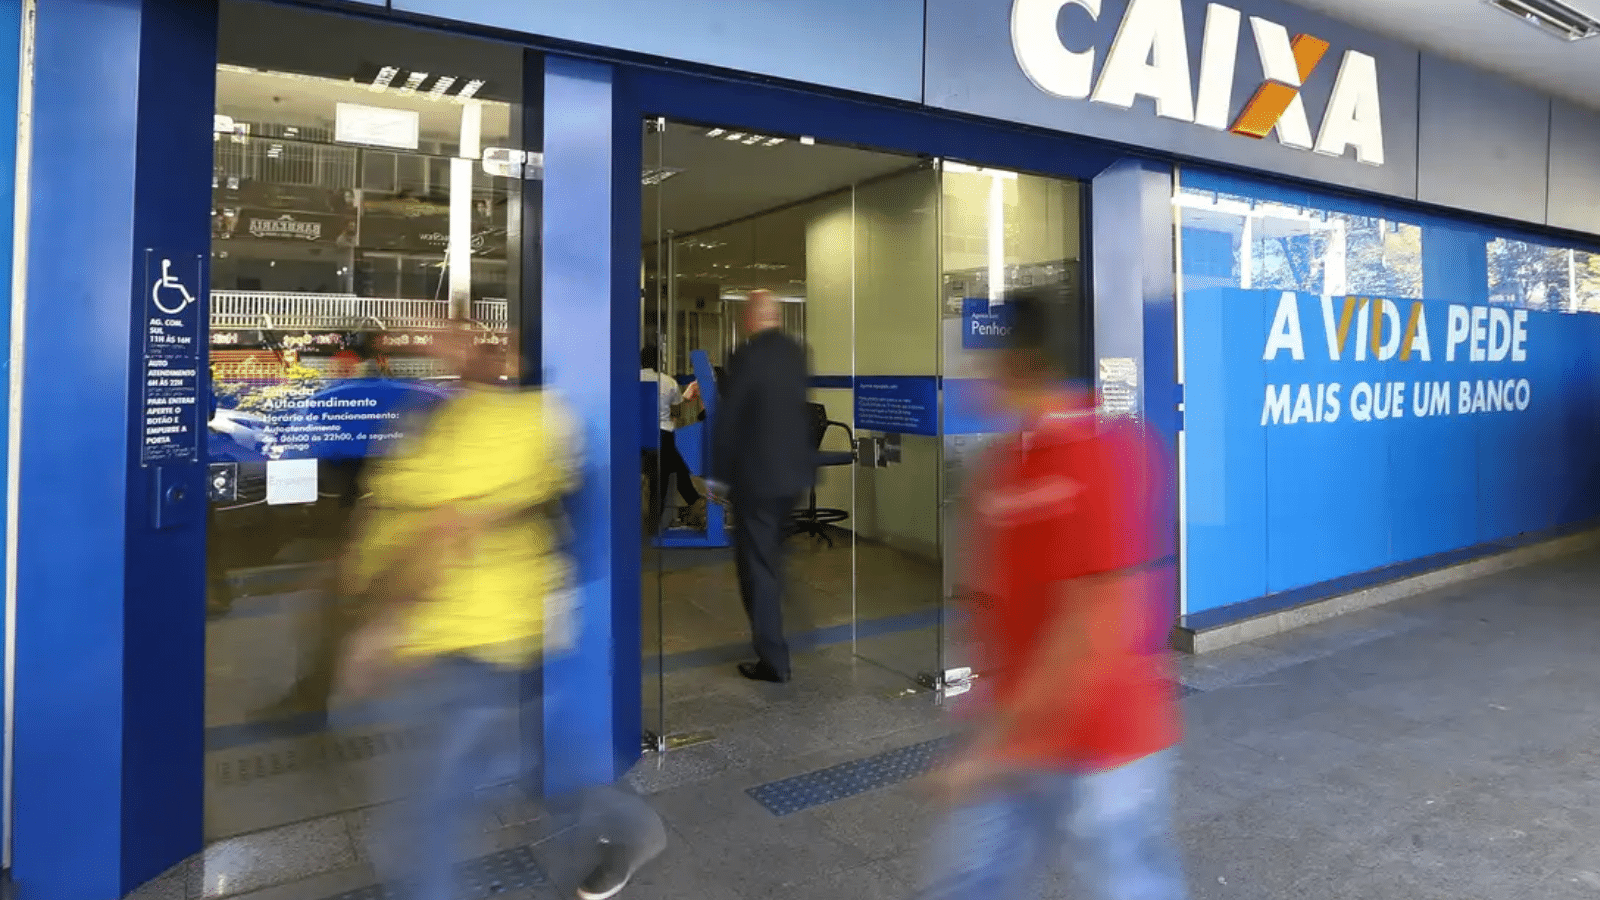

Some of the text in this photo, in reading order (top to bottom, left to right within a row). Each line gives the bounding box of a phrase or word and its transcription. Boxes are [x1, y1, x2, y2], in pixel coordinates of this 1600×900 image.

[1010, 0, 1384, 166] CAIXA
[1263, 291, 1528, 362] A VIDA PEDE
[148, 360, 169, 368] AUTO
[264, 397, 378, 409] Autoatendimento
[1260, 378, 1531, 426] MAIS QUE UM BANCO
[174, 406, 182, 414] O
[306, 412, 320, 421] de
[321, 411, 400, 421] Funcionamento:
